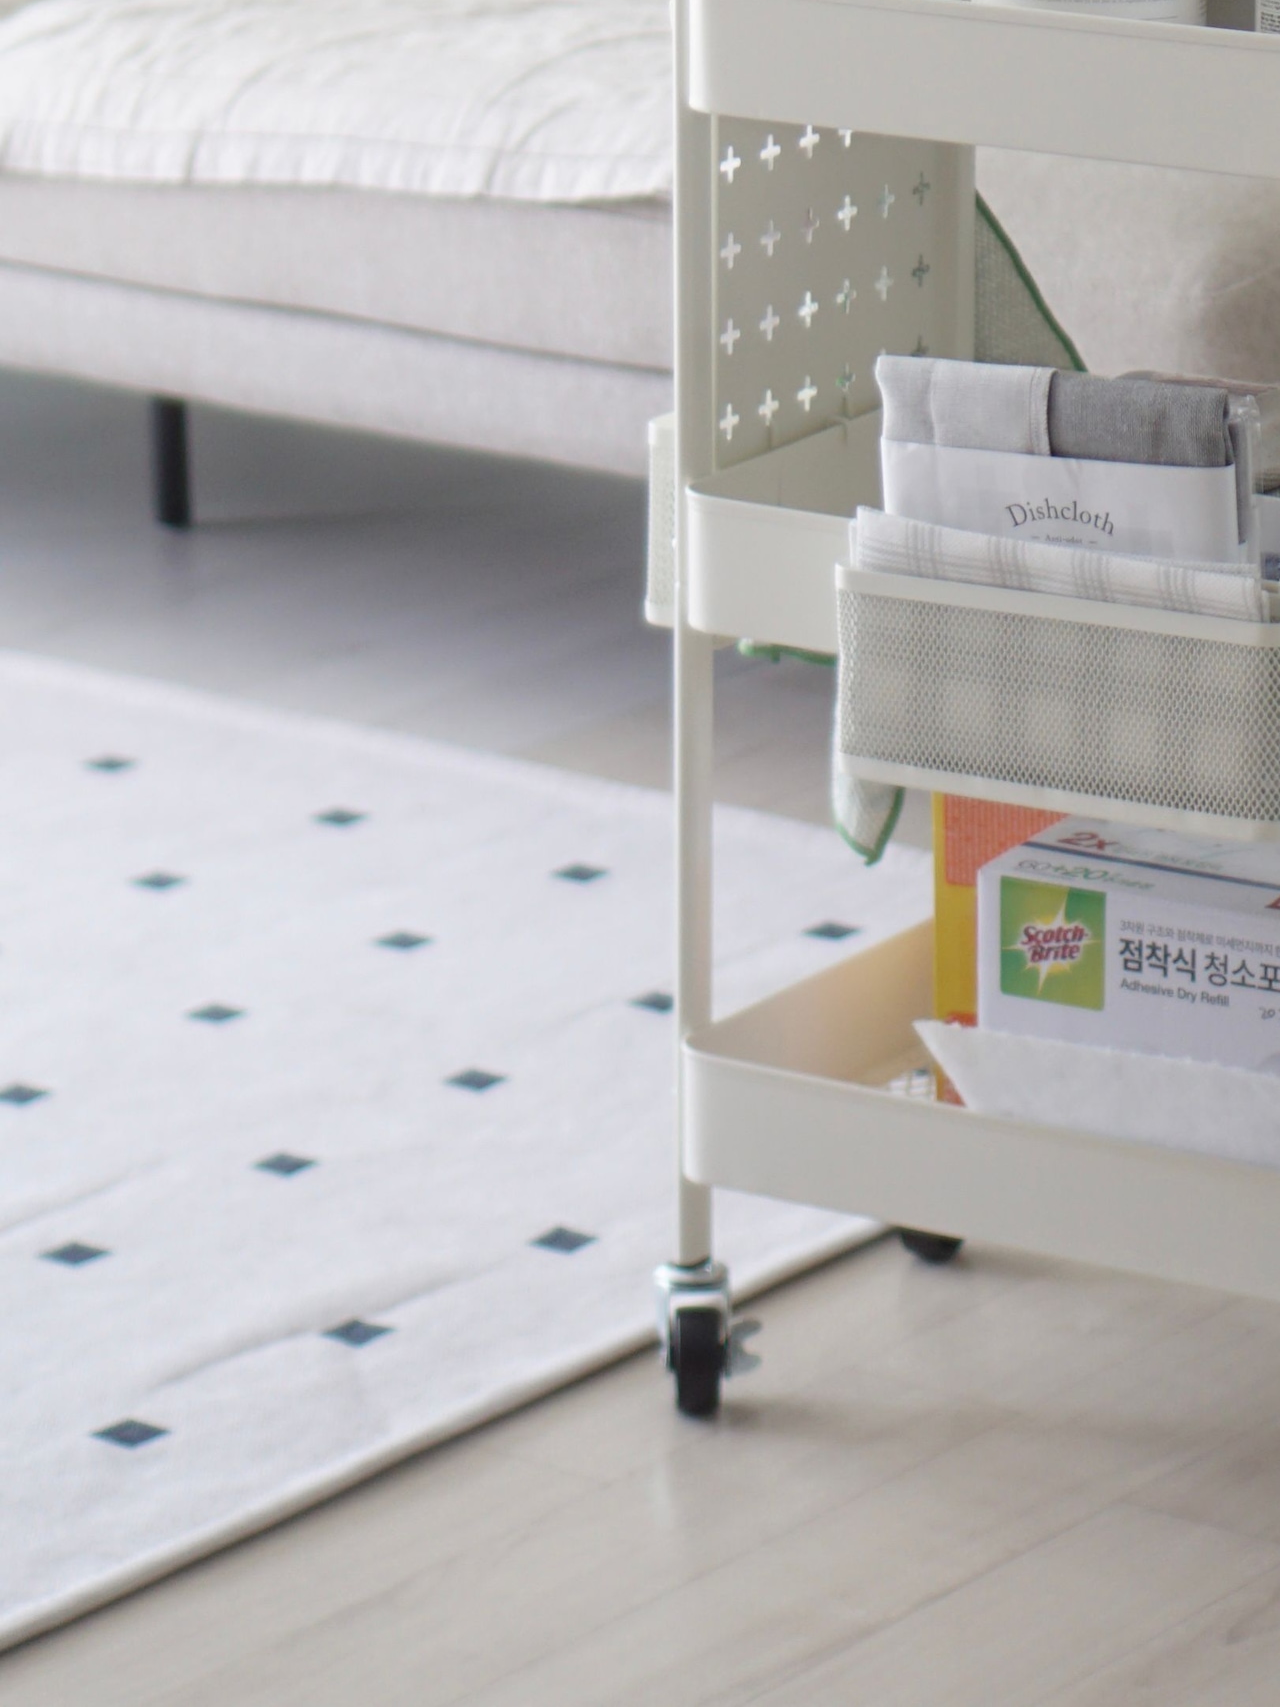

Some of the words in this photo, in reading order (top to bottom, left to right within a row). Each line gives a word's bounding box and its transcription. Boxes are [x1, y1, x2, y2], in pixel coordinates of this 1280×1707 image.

[1004, 497, 1115, 536] Dishcloth
[1028, 943, 1081, 964] Brite
[1120, 919, 1145, 933] 3차원
[1147, 923, 1175, 939] 구조와
[1215, 935, 1275, 958] 미세먼지까지
[1118, 937, 1197, 983] 점착식
[1120, 978, 1175, 999] Adhesive
[1176, 987, 1198, 1003] Dry
[1200, 991, 1230, 1007] Refill
